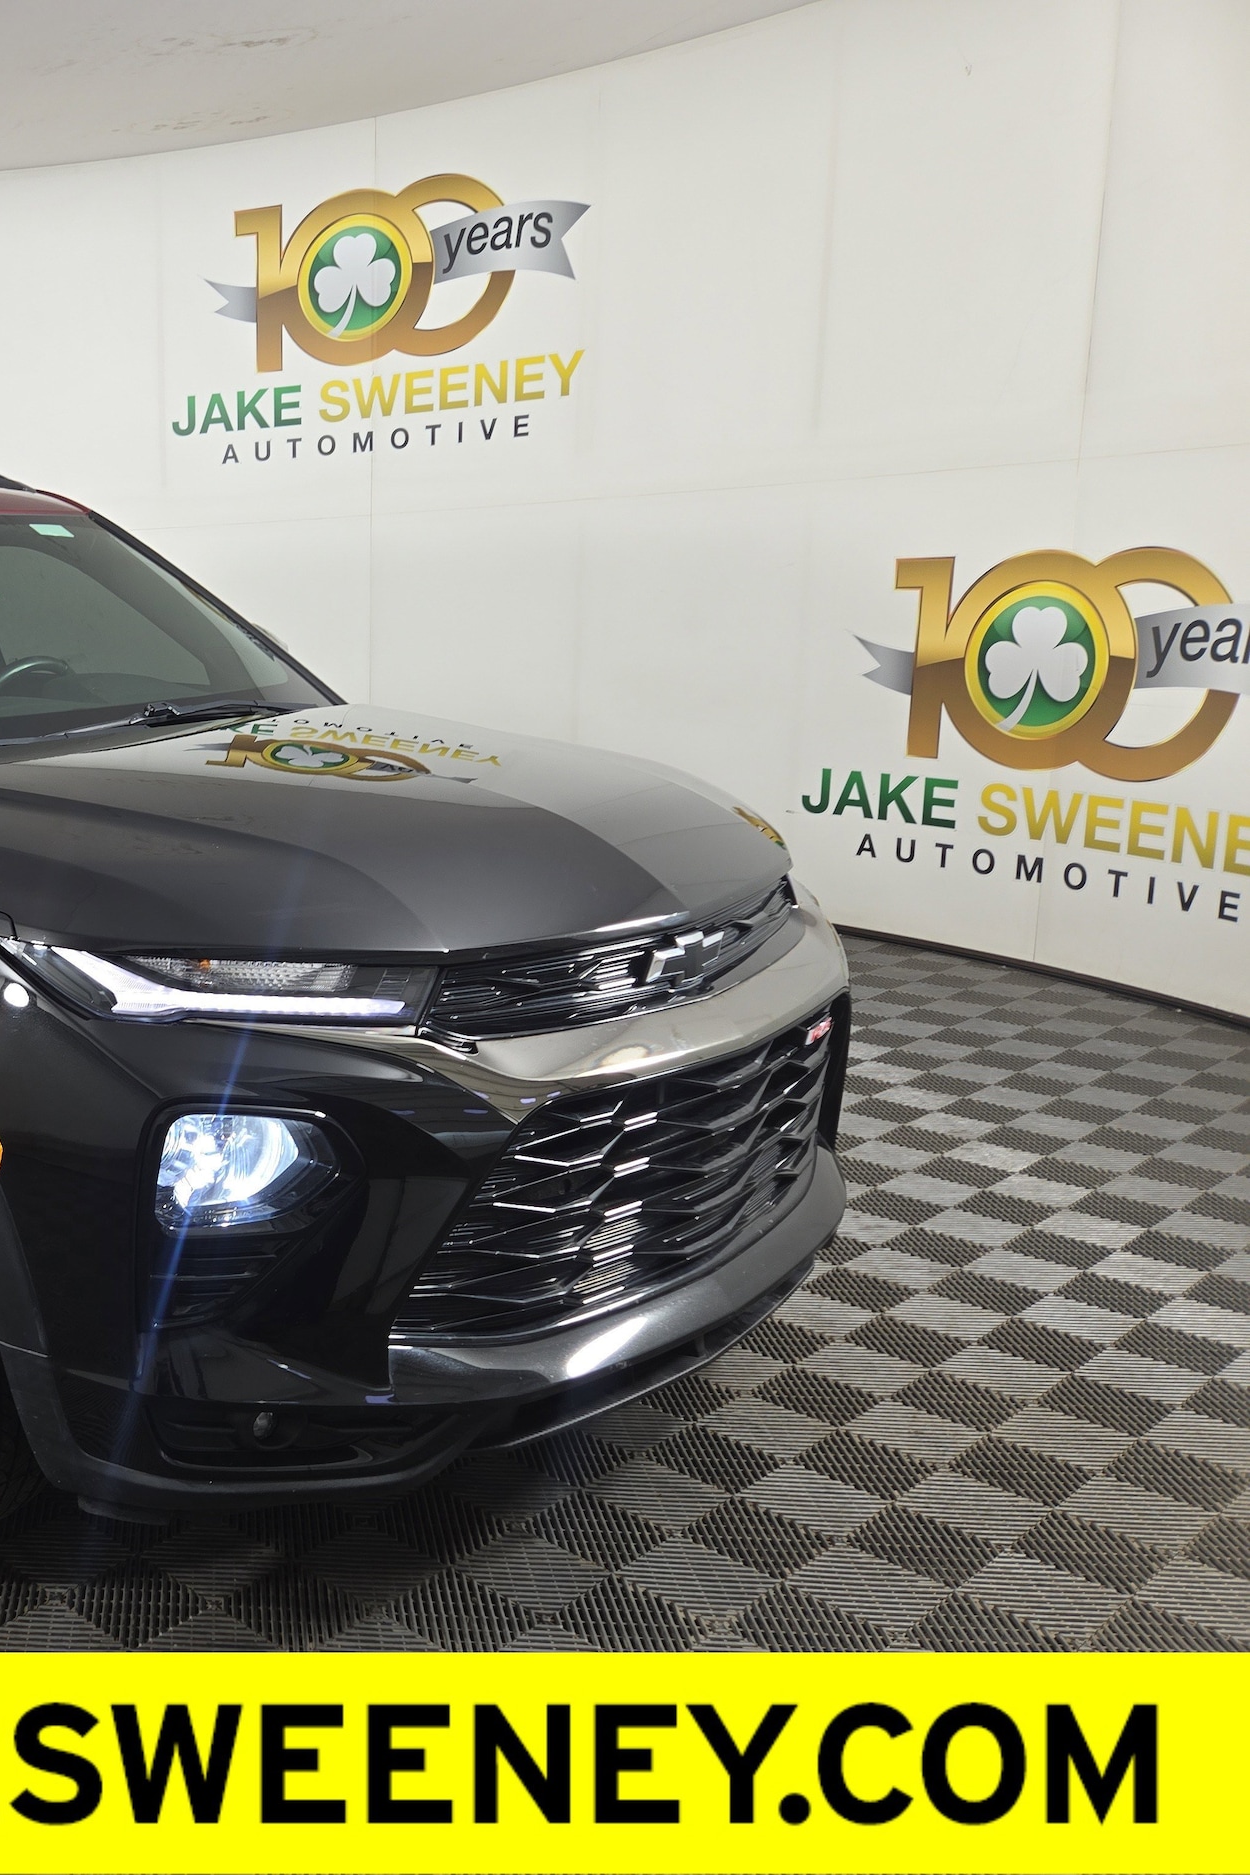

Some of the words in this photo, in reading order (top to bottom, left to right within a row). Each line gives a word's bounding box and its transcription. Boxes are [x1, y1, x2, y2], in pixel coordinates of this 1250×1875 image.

[442, 211, 554, 274] years
[172, 385, 302, 436] JAKE
[319, 350, 585, 423] SWEENEY
[221, 414, 531, 465] AUTOMOTIVE
[801, 767, 959, 829] JAKE
[856, 833, 1241, 922] AUTOMOTIVE
